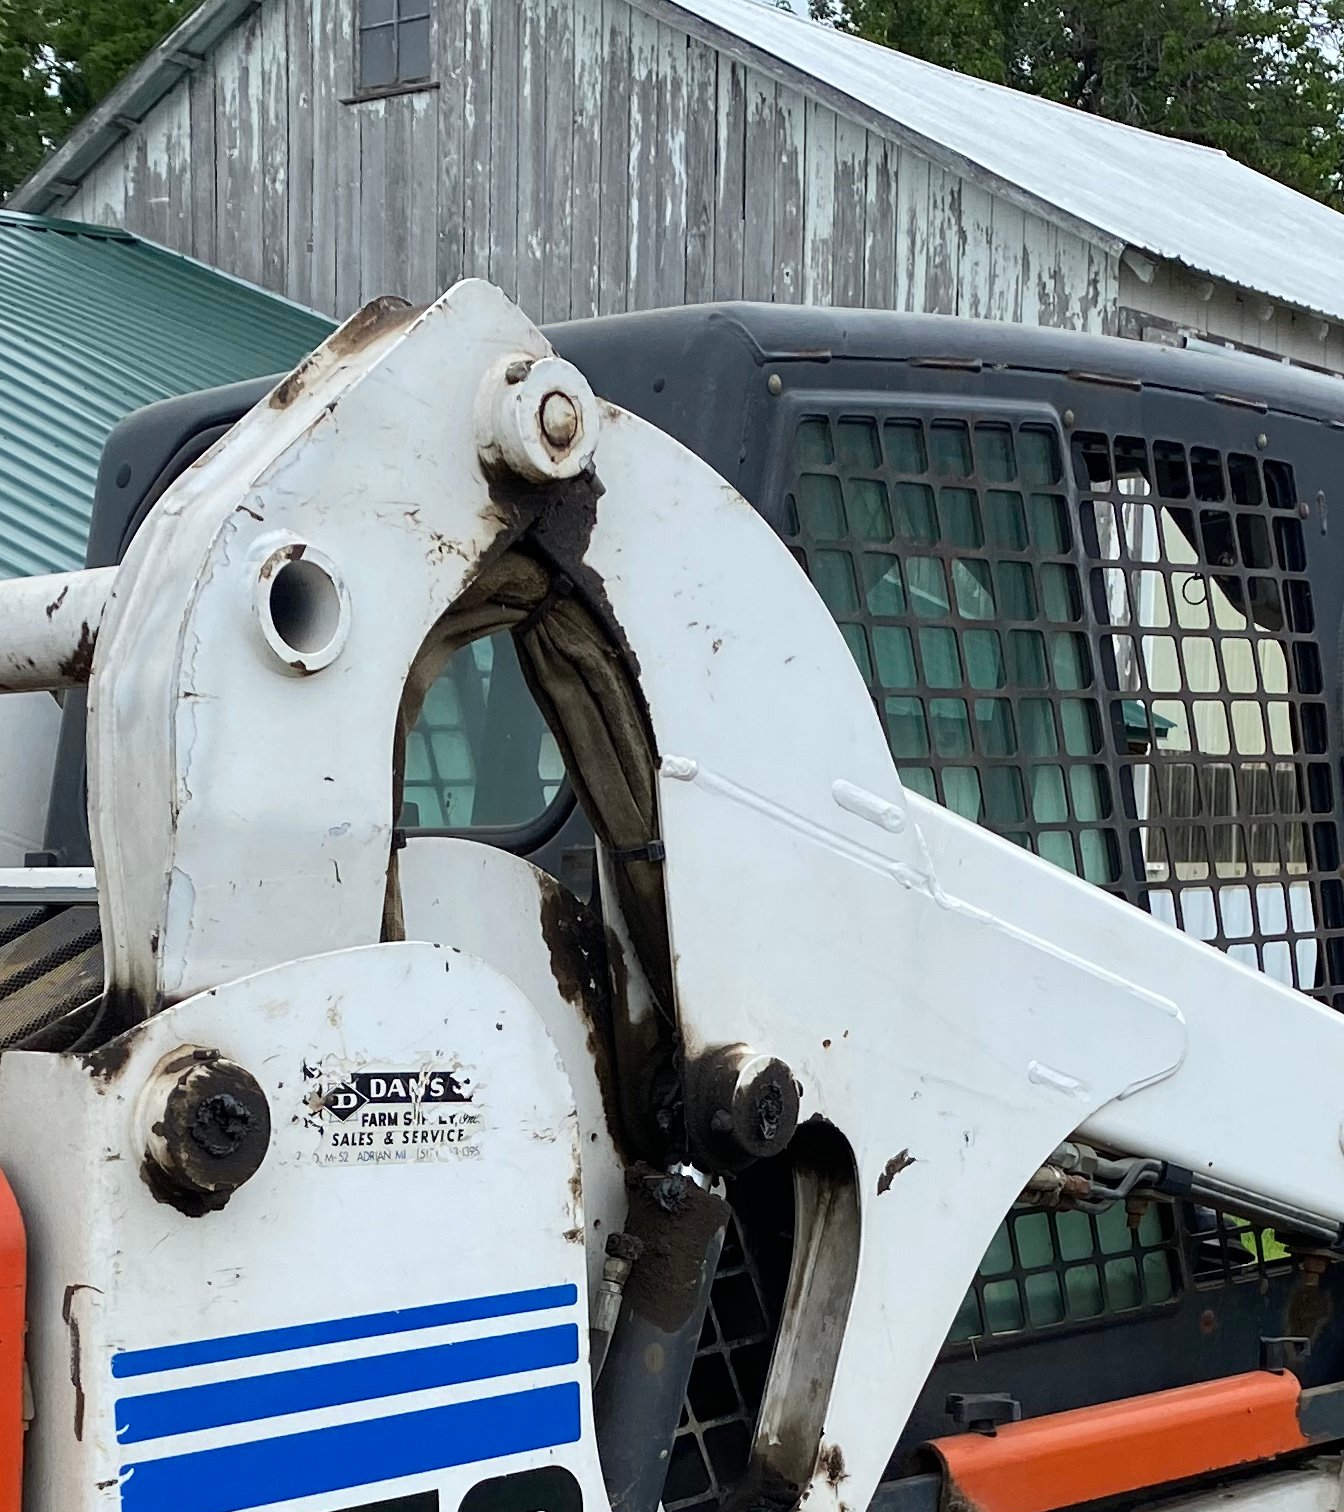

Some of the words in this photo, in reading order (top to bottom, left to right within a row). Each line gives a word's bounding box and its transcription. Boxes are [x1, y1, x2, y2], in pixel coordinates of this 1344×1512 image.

[361, 1111, 398, 1127] FARM
[331, 1131, 374, 1147] SALES
[383, 1131, 394, 1145] &
[401, 1128, 465, 1144] SERVICE
[356, 1150, 392, 1162] ADRIAN
